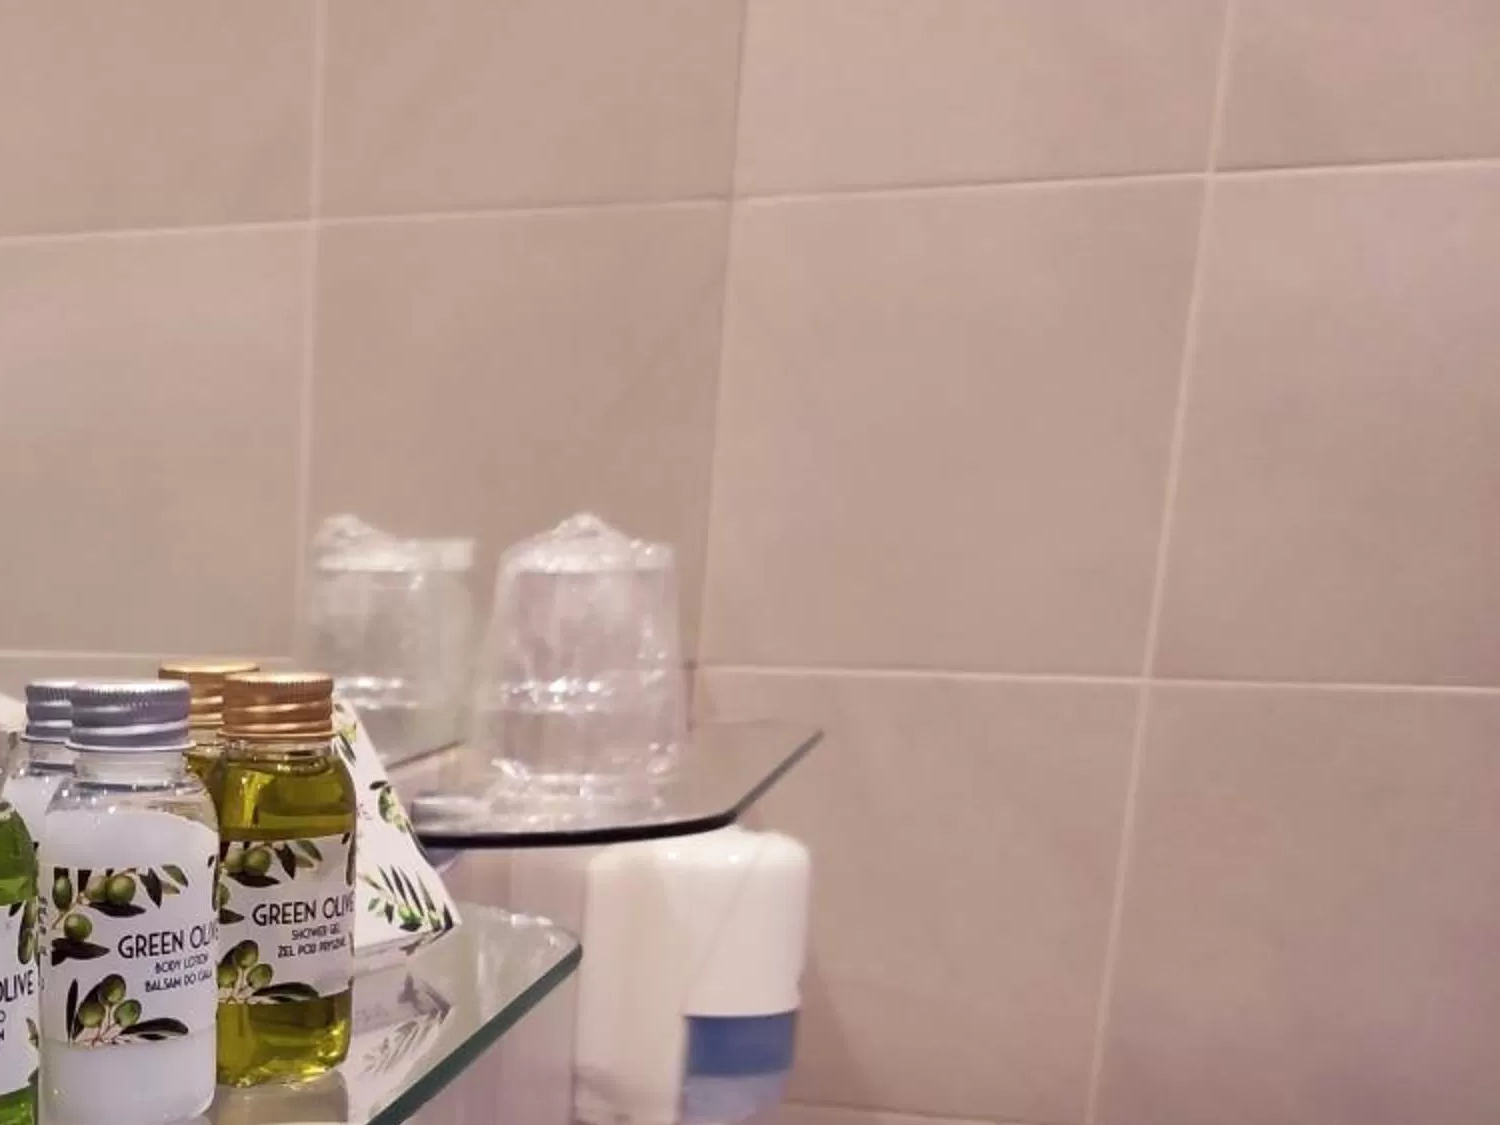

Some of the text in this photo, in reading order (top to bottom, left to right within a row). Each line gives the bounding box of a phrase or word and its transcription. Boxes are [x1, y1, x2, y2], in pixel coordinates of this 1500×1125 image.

[252, 899, 317, 926] GREEN
[118, 929, 184, 959] GREEN
[155, 961, 180, 974] BODY
[145, 977, 181, 992] BALSAM
[184, 972, 197, 986] DO
